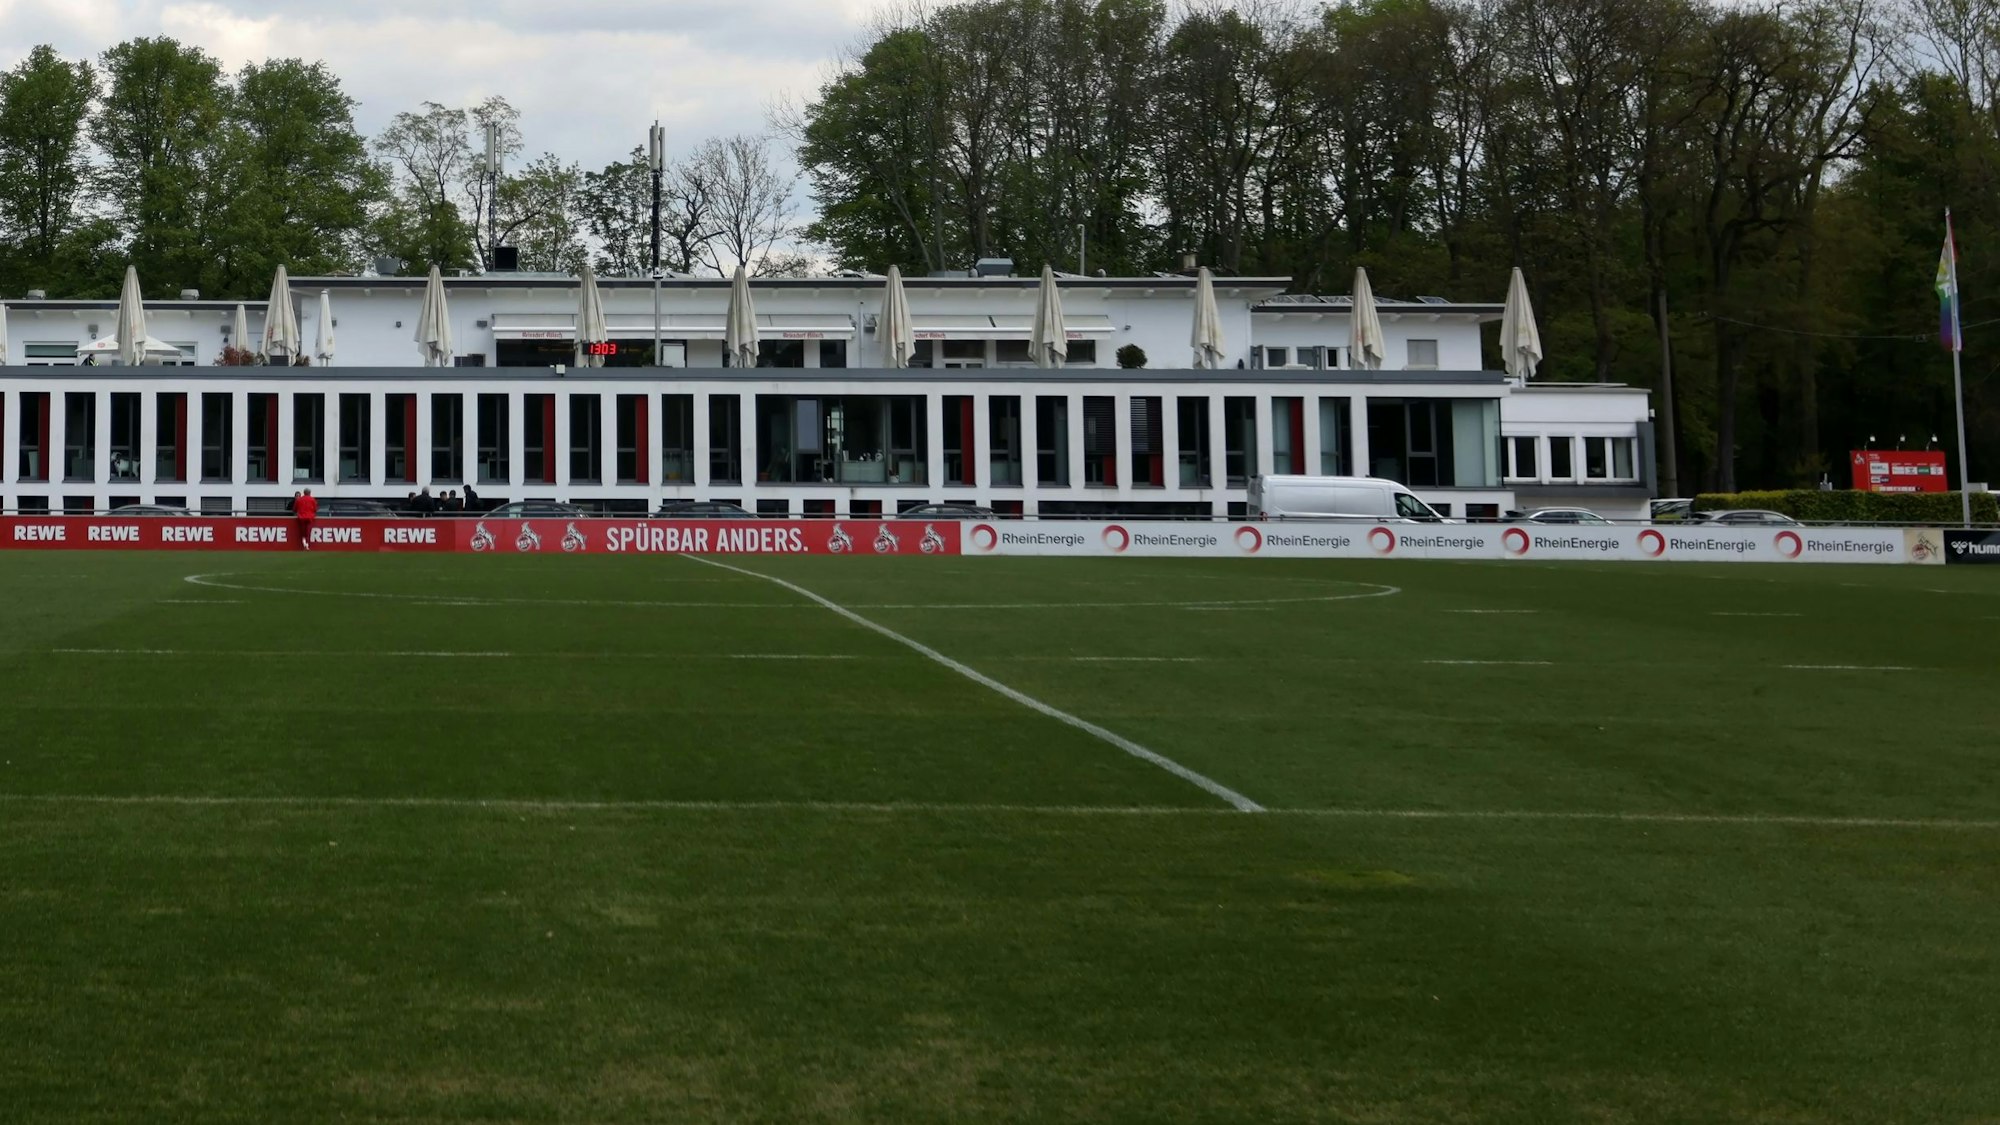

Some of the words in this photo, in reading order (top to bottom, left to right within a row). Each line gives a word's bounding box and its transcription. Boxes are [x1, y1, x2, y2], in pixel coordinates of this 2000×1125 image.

[15, 525, 66, 541] REWE
[88, 526, 140, 542] REWE
[162, 526, 214, 542] REWE
[236, 527, 288, 543] REWE
[310, 527, 362, 543] REWE
[384, 527, 437, 544] REWE
[606, 524, 709, 552] SPÜRBAR
[715, 527, 809, 552] ANDERS.
[1001, 534, 1085, 550] RheinEnergie
[1133, 535, 1217, 551] RheinEnergie
[1266, 536, 1351, 552] RheinEnergie
[1399, 537, 1484, 553] RheinEnergie
[1534, 538, 1620, 554] RheinEnergie
[1670, 539, 1756, 555] RheinEnergie
[1806, 540, 1894, 556] RheinEnergie
